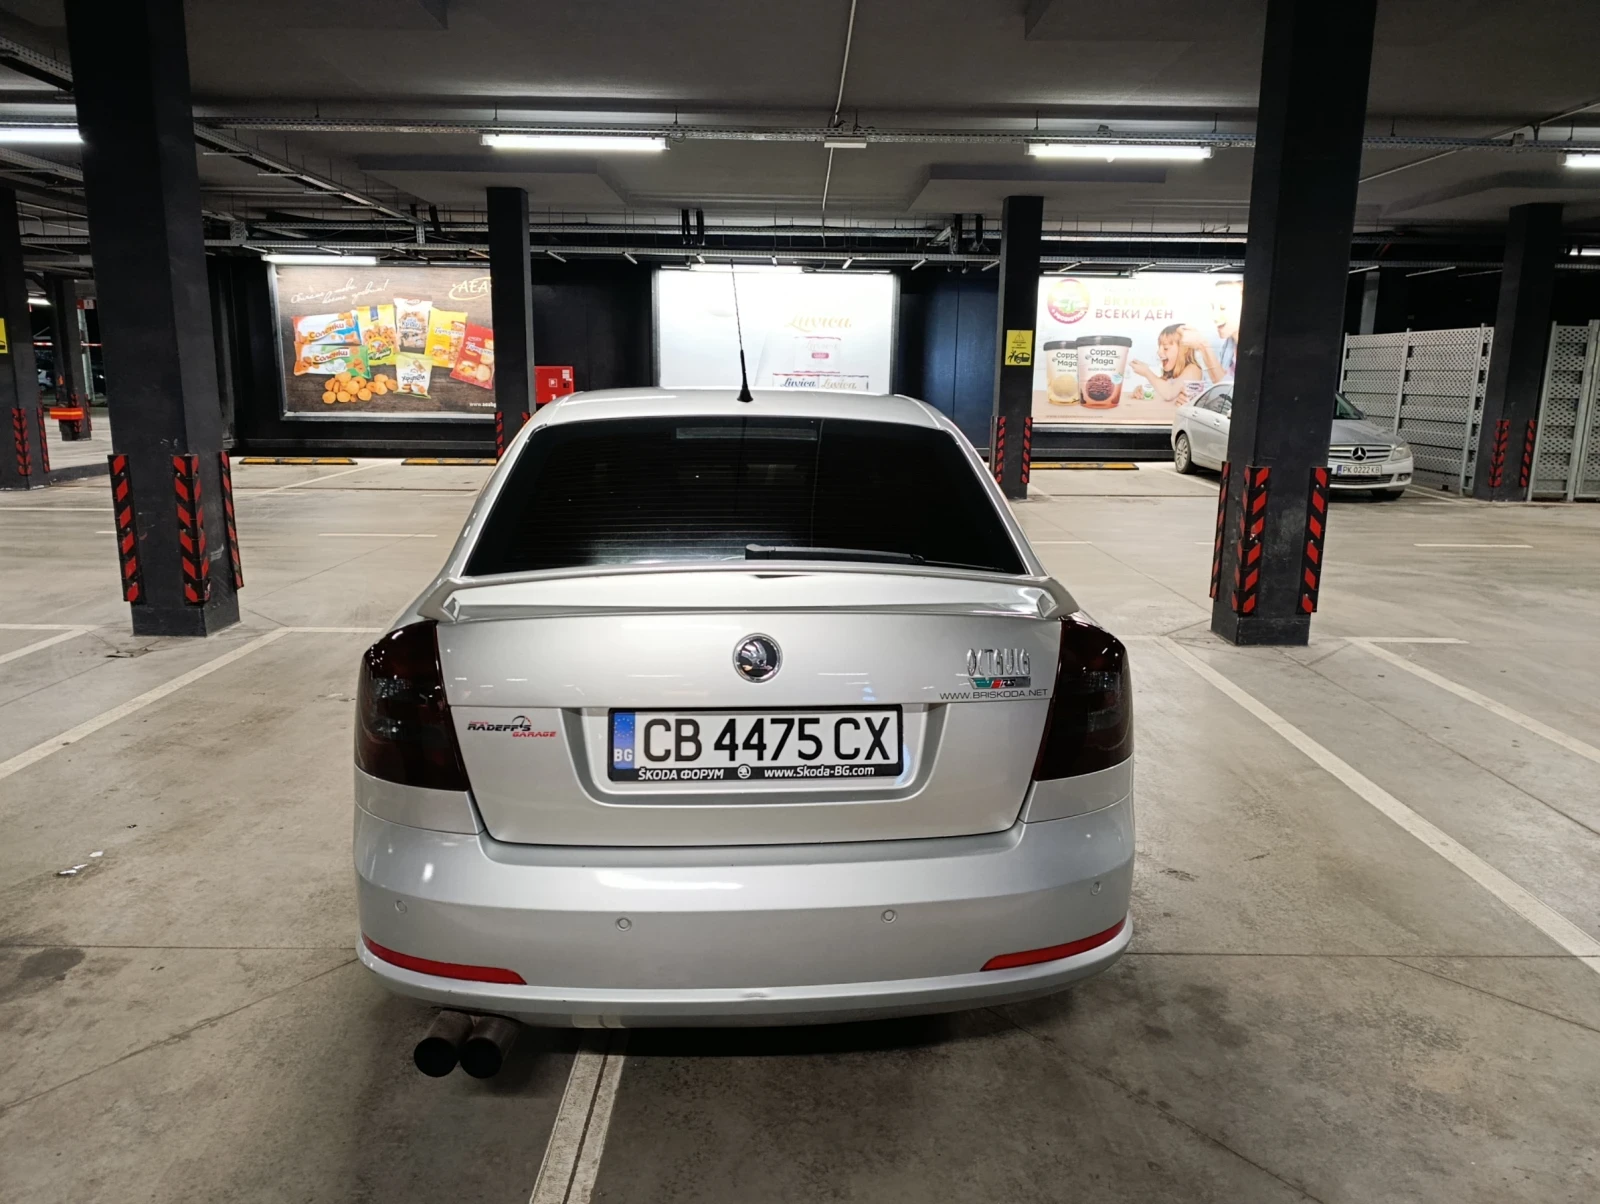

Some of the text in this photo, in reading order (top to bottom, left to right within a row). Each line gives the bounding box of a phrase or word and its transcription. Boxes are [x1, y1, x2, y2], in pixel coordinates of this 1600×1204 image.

[1095, 308, 1140, 319] ВСЕКИ
[1144, 309, 1174, 321] ДЕН
[1089, 348, 1117, 356] Coppa
[1091, 357, 1114, 365] Maga
[1353, 466, 1371, 474] 0222
[939, 688, 1048, 700] WWW.BRISKODA.NET
[643, 716, 891, 762] CB 4475 CX
[613, 748, 633, 762] BG
[638, 767, 725, 780] ŠKODA ФОРУМ
[764, 764, 875, 778] www.Skoda-BG.com
